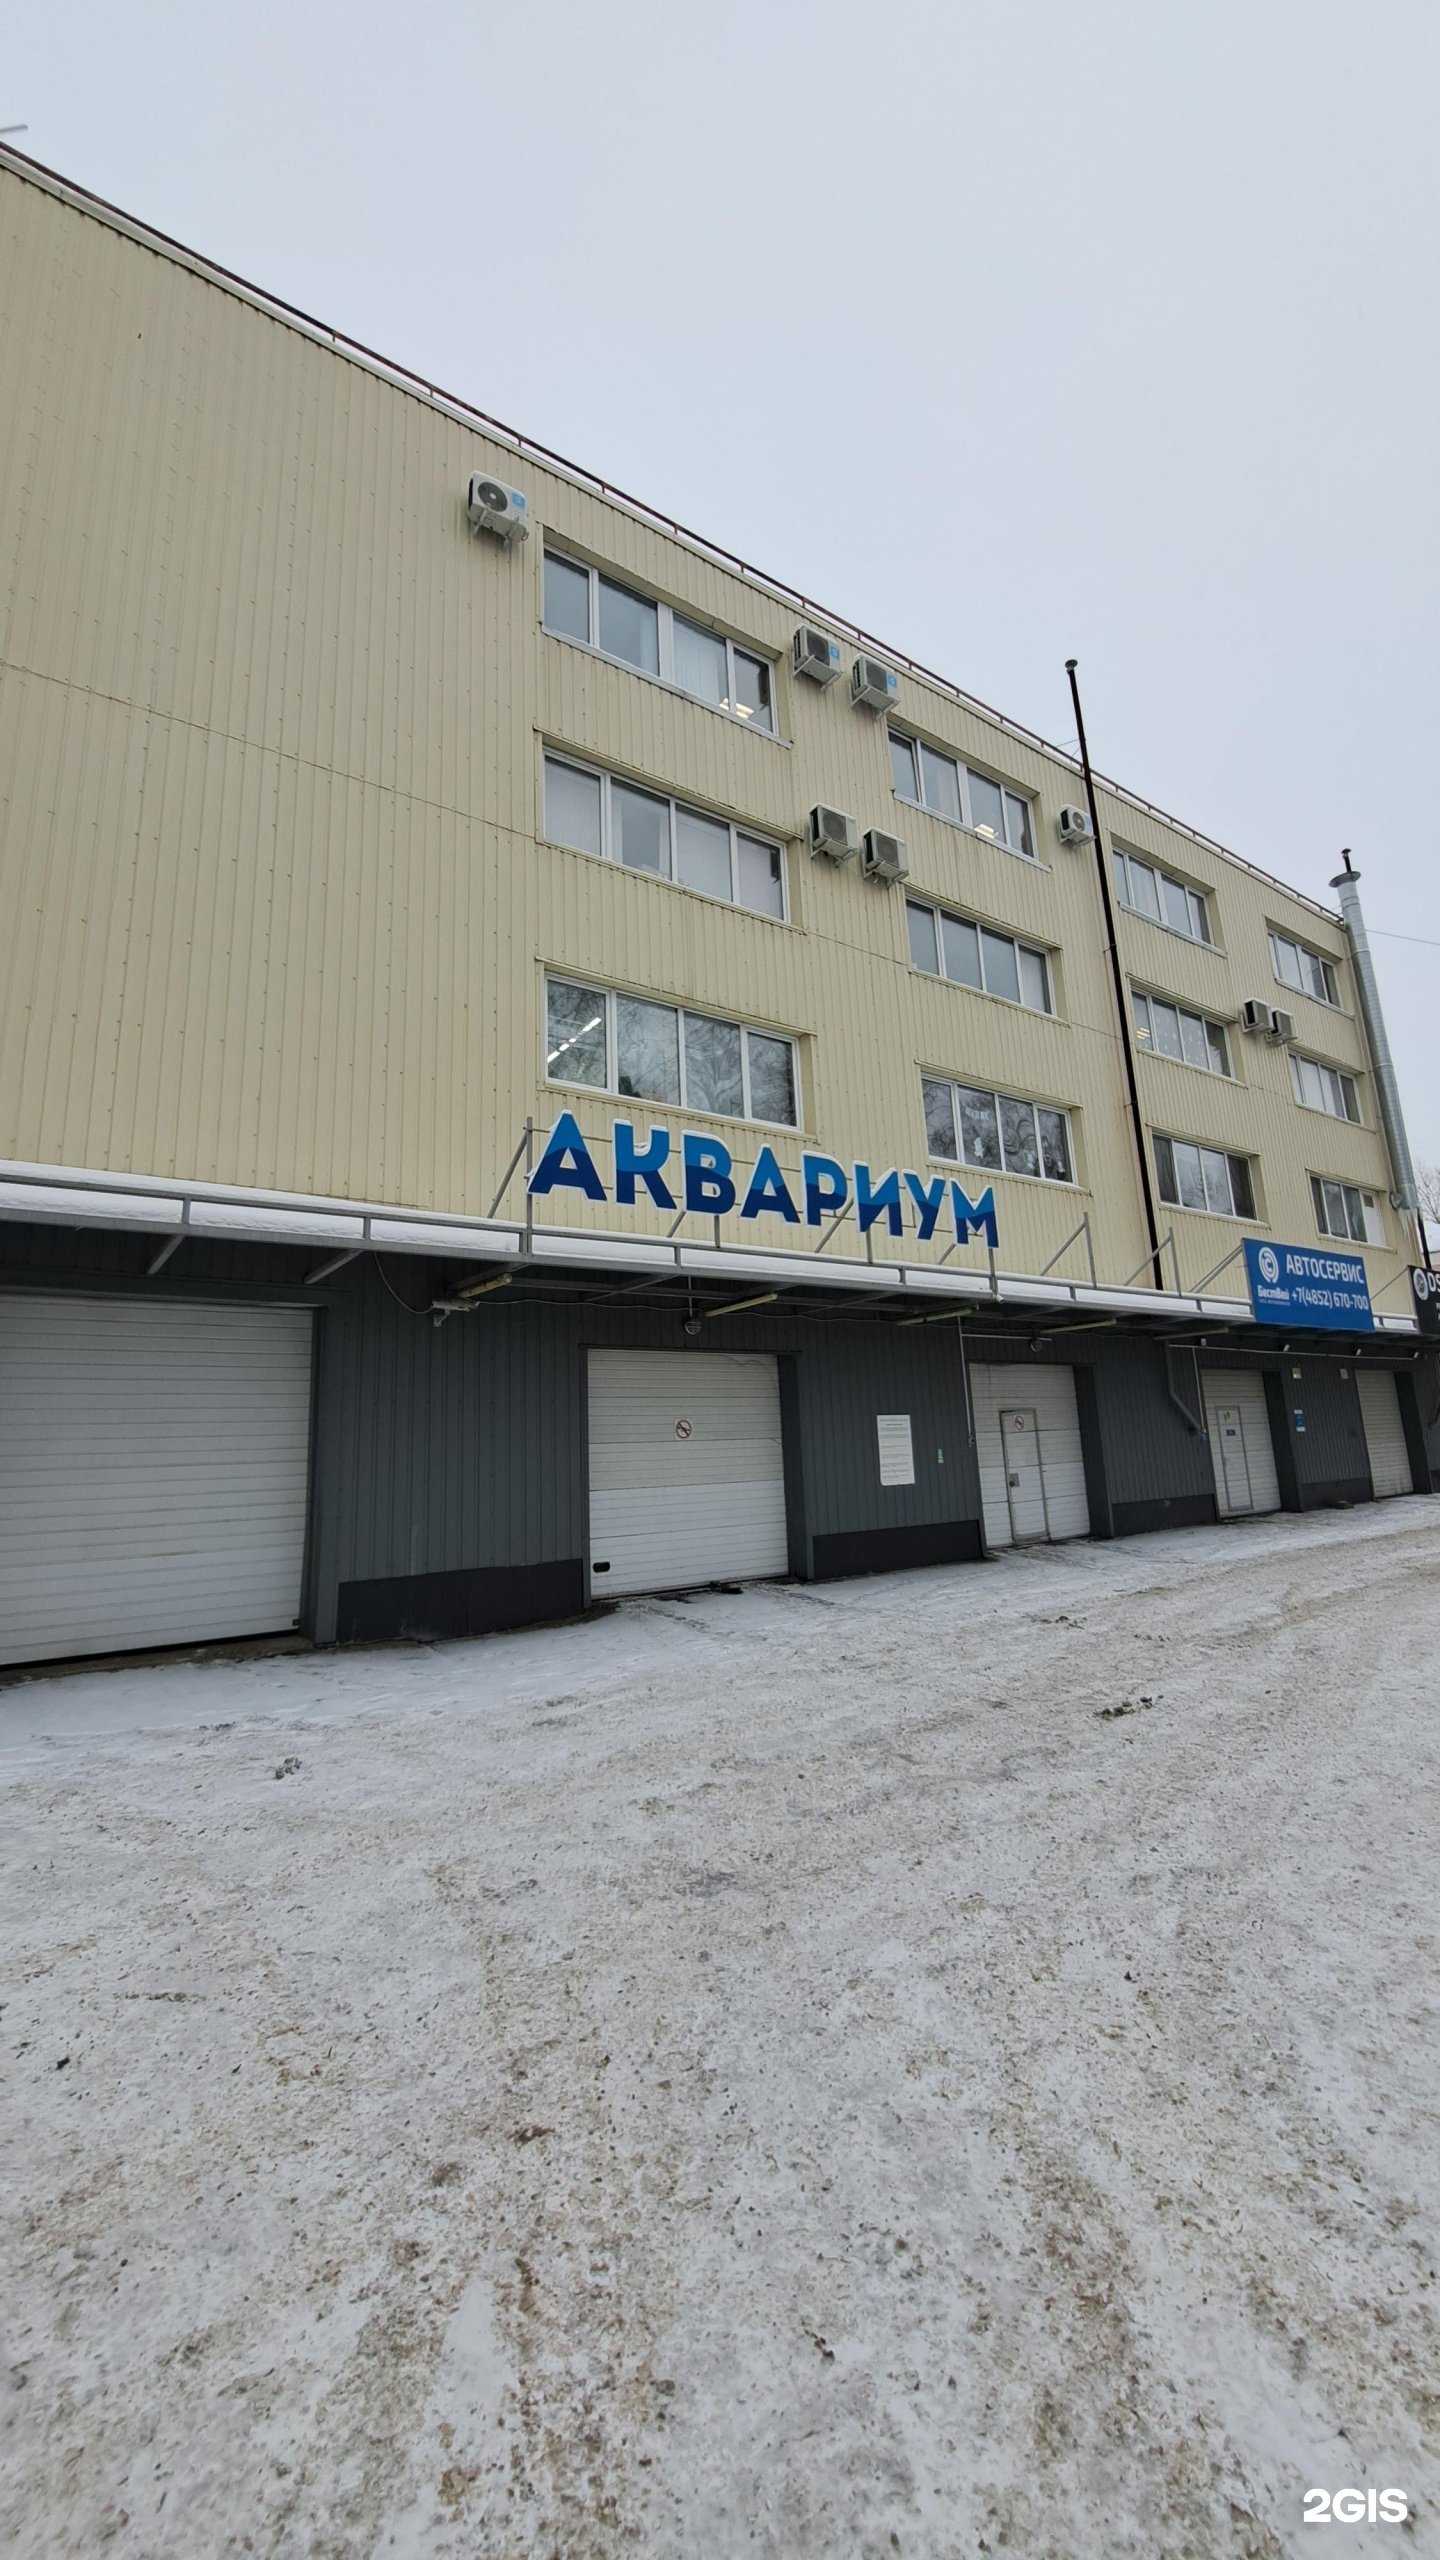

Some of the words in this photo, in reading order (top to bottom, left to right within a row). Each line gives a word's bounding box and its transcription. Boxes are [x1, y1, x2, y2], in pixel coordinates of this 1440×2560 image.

[527, 1108, 999, 1248] АКВАРИУМ
[1286, 1254, 1365, 1284] АВТОСЕРВИС
[1291, 1286, 1333, 1309] +7(4852)
[1333, 1291, 1369, 1310] 670-700
